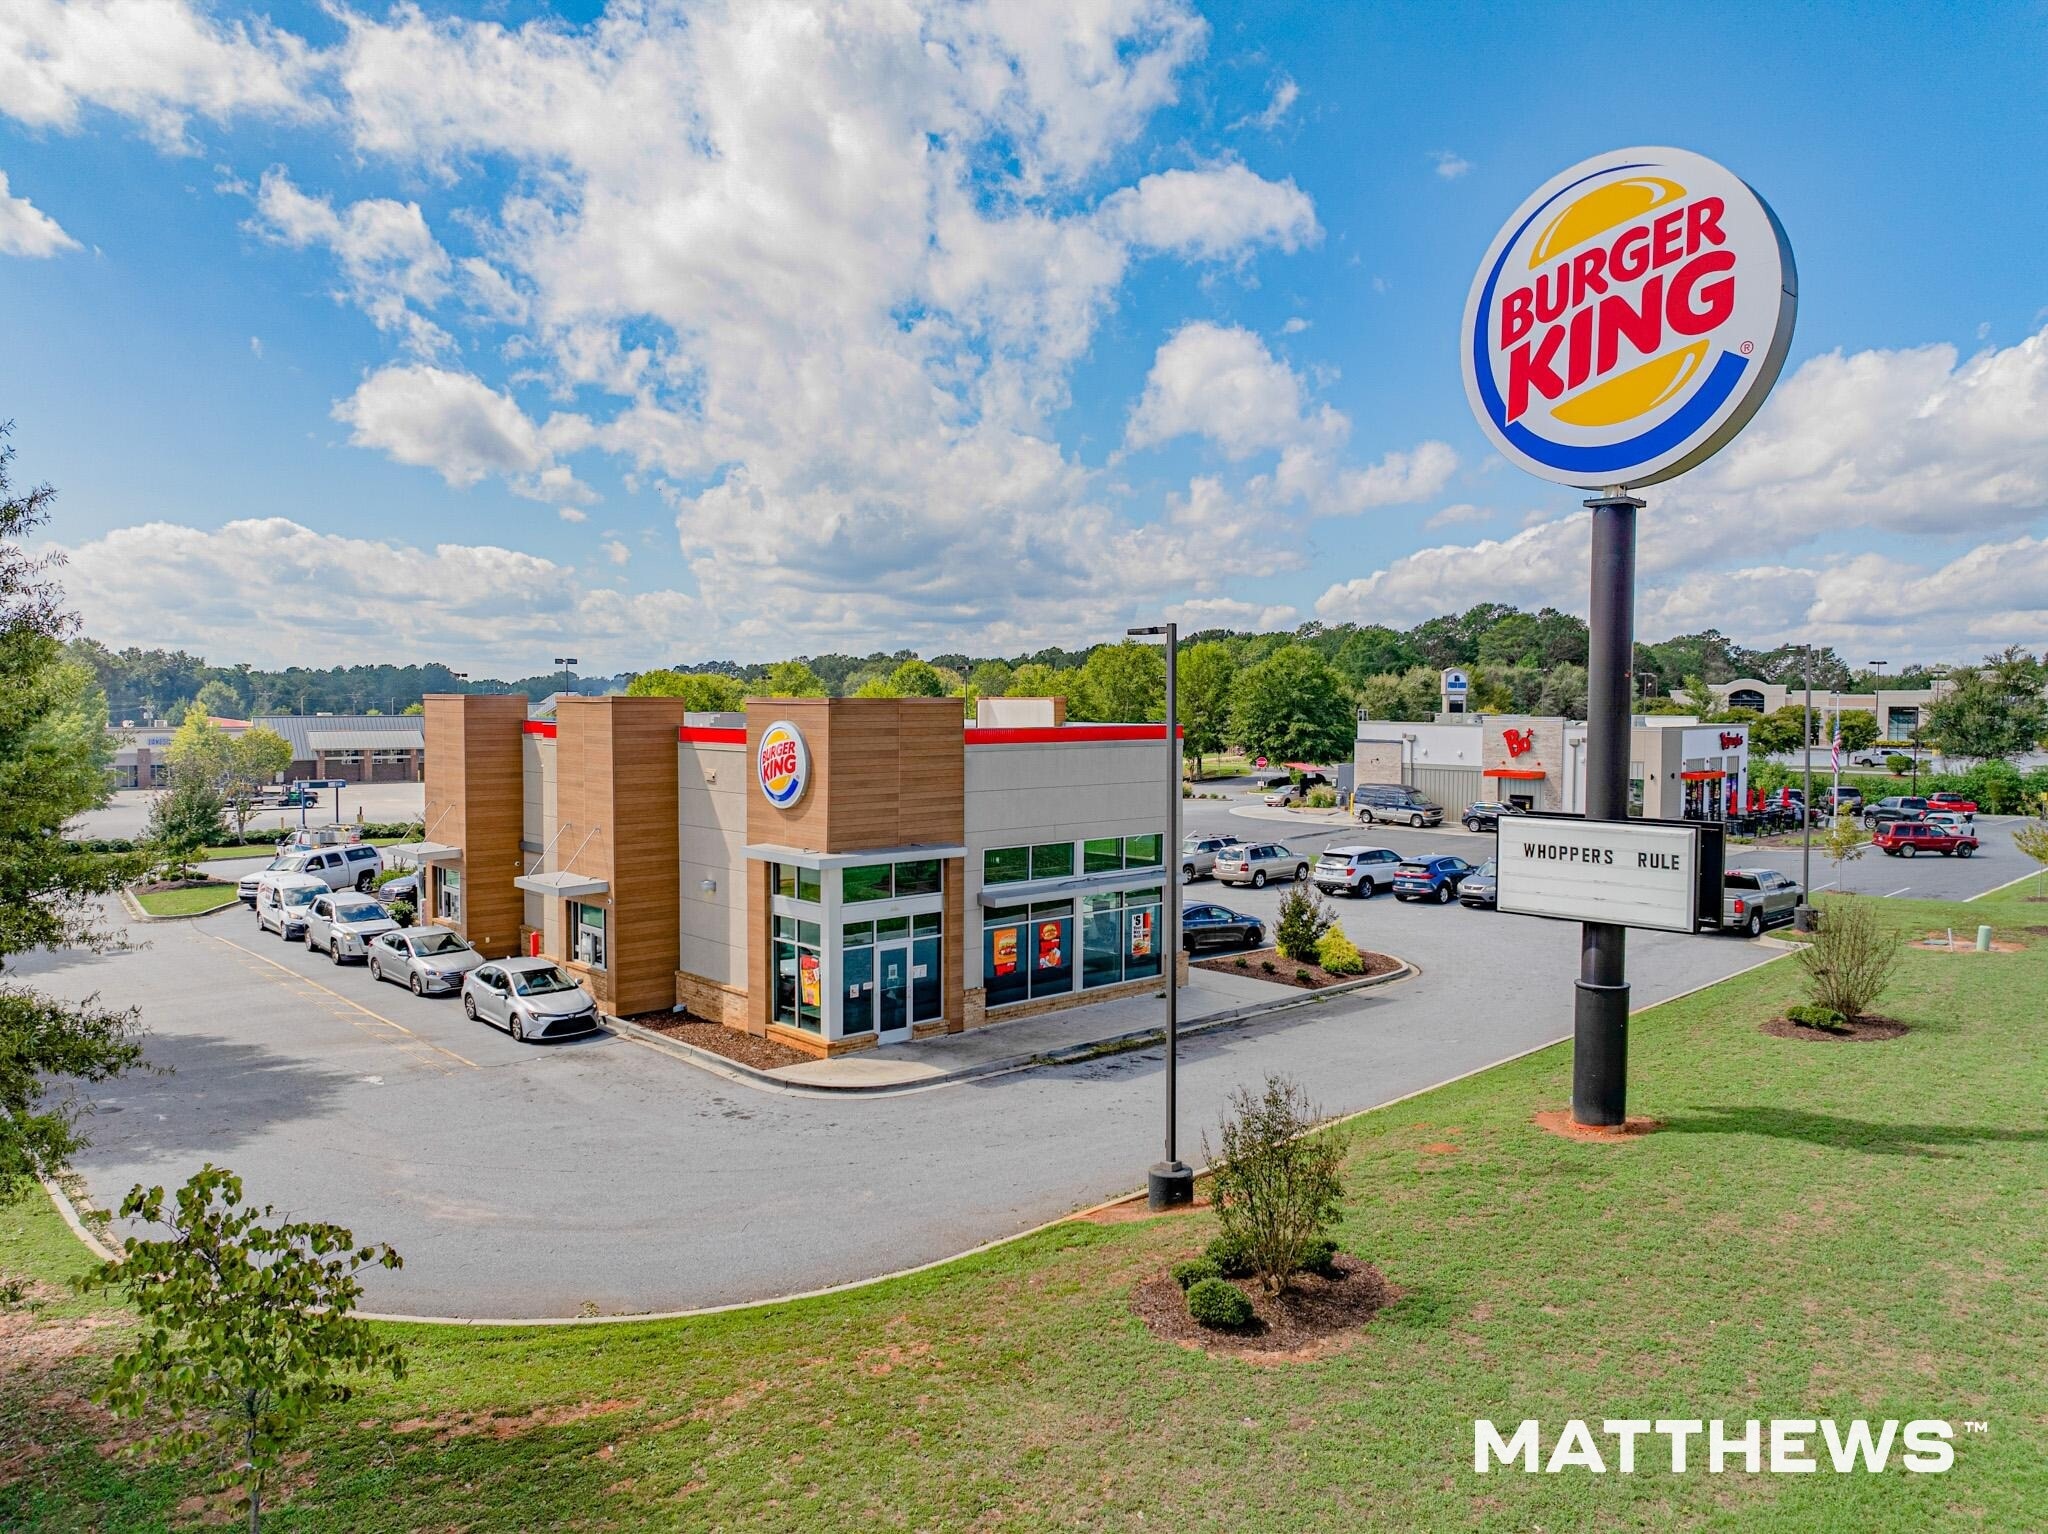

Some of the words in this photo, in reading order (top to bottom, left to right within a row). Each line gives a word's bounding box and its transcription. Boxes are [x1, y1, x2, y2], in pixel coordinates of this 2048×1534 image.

[1501, 197, 1726, 350] BURGER
[1507, 251, 1736, 423] KING
[763, 741, 796, 765] BURGER
[763, 754, 796, 784] KING
[1523, 842, 1614, 865] WHOPPERS
[1637, 852, 1680, 871] RULE
